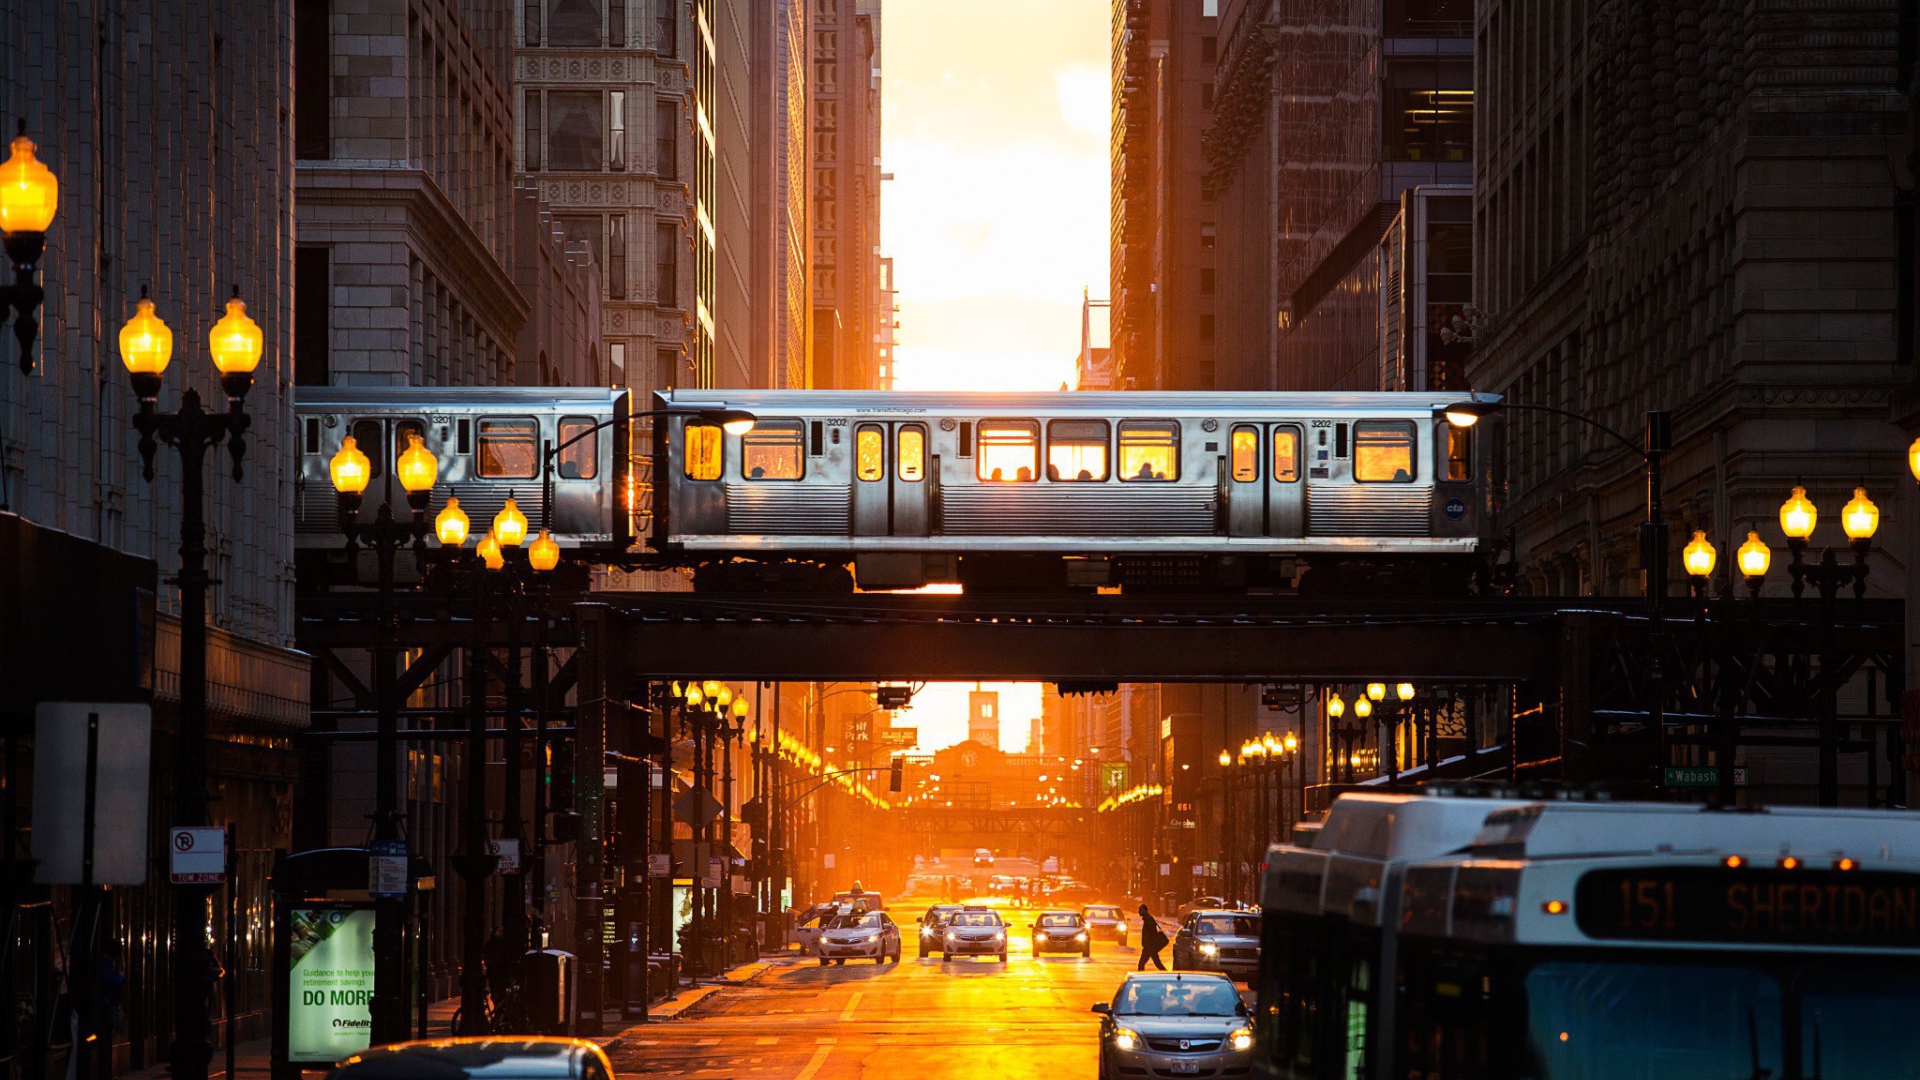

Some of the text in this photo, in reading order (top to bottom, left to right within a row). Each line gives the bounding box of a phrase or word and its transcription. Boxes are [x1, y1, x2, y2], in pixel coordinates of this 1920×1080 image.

[432, 416, 452, 424] 3201
[826, 418, 847, 426] 3202
[1311, 420, 1332, 428] 3202
[1446, 502, 1463, 512] cta
[845, 721, 867, 731] Self
[845, 731, 868, 740] Park
[1675, 770, 1716, 782] Wabash
[197, 873, 219, 881] ZONE
[1619, 879, 1918, 932] 151 SHERIDAN
[303, 969, 335, 977] Guidance
[336, 969, 343, 977] to
[345, 969, 360, 978] help
[340, 979, 366, 987] savings
[303, 990, 325, 1006] DO
[342, 1019, 371, 1027] Fidelit
